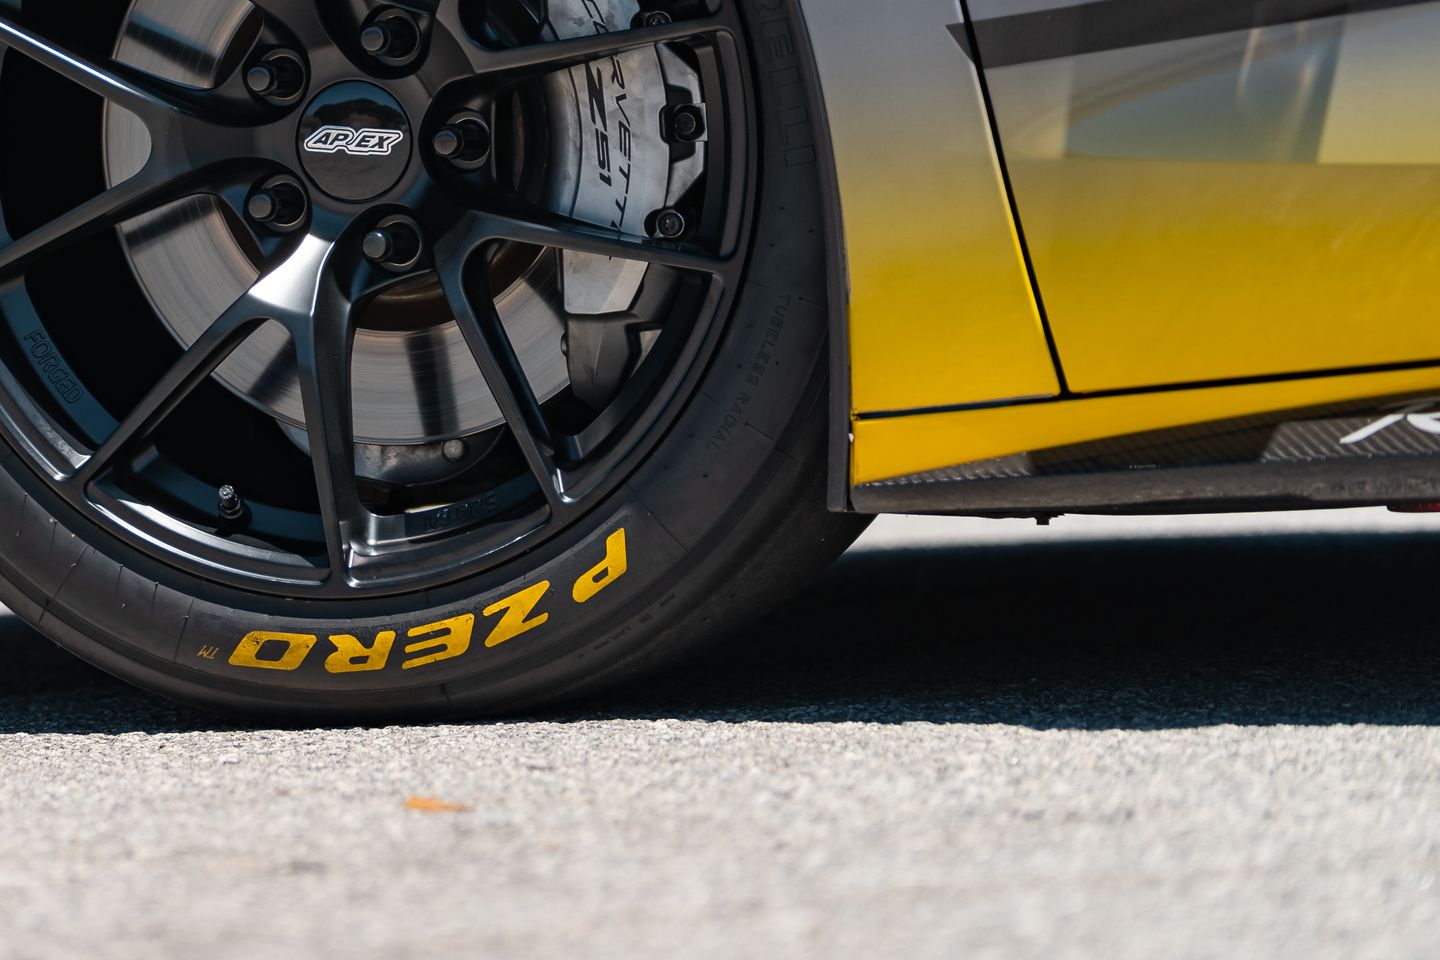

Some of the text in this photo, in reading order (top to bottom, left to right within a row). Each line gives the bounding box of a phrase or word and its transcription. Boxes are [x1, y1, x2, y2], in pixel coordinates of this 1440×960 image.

[309, 128, 399, 152] APEX
[584, 60, 613, 188] Z51
[22, 327, 85, 405] FORGED
[744, 293, 794, 388] TUBELESS
[571, 527, 629, 604] P
[227, 579, 551, 675] ZERO
